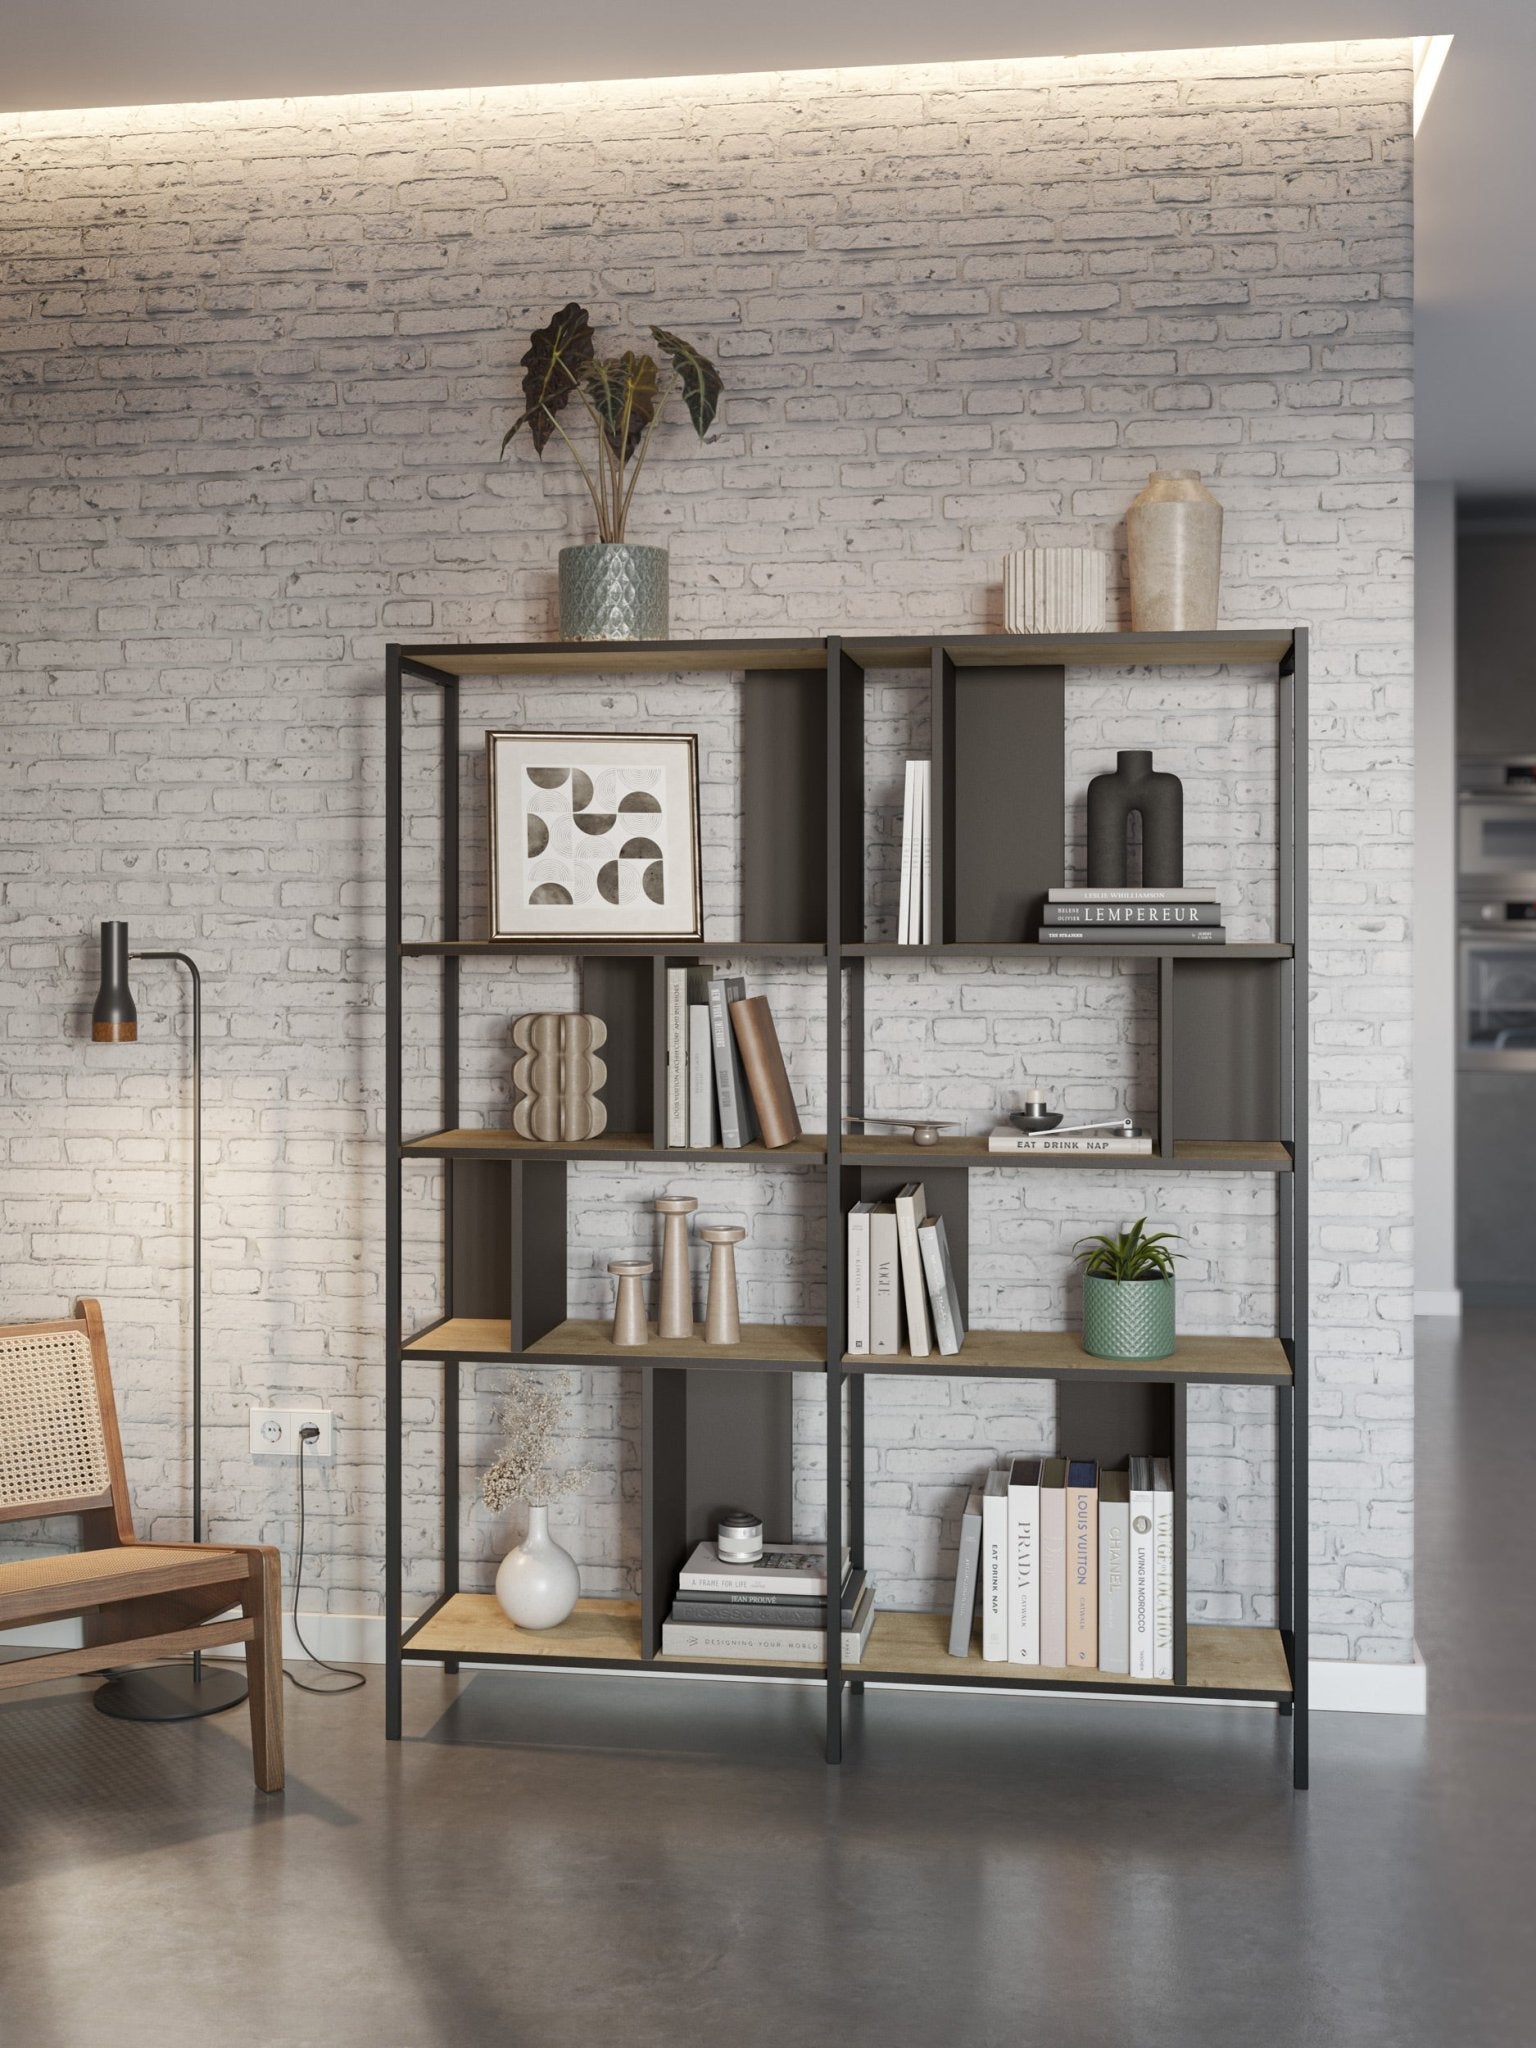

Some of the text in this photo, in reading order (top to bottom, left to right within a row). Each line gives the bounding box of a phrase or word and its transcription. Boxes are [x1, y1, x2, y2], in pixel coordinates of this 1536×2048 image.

[1084, 908, 1199, 921] LEMPEREUR
[1017, 1141, 1109, 1150] EAT DRINK NAP
[878, 1262, 890, 1296] VOGUE
[1077, 1494, 1087, 1531] LOUIS
[1018, 1522, 1031, 1588] PRADA
[1077, 1533, 1087, 1586] VUITTON
[1109, 1526, 1121, 1593] CHANEL
[699, 1579, 719, 1587] FRAME
[722, 1580, 733, 1588] FOR
[1138, 1577, 1145, 1585] IN
[749, 1596, 777, 1604] PROUVÉ
[1137, 1587, 1145, 1633] MOROCCO
[1157, 1572, 1172, 1649] LOCATION
[683, 1606, 753, 1620] PICASSO
[704, 1638, 753, 1647] DESIGNING
